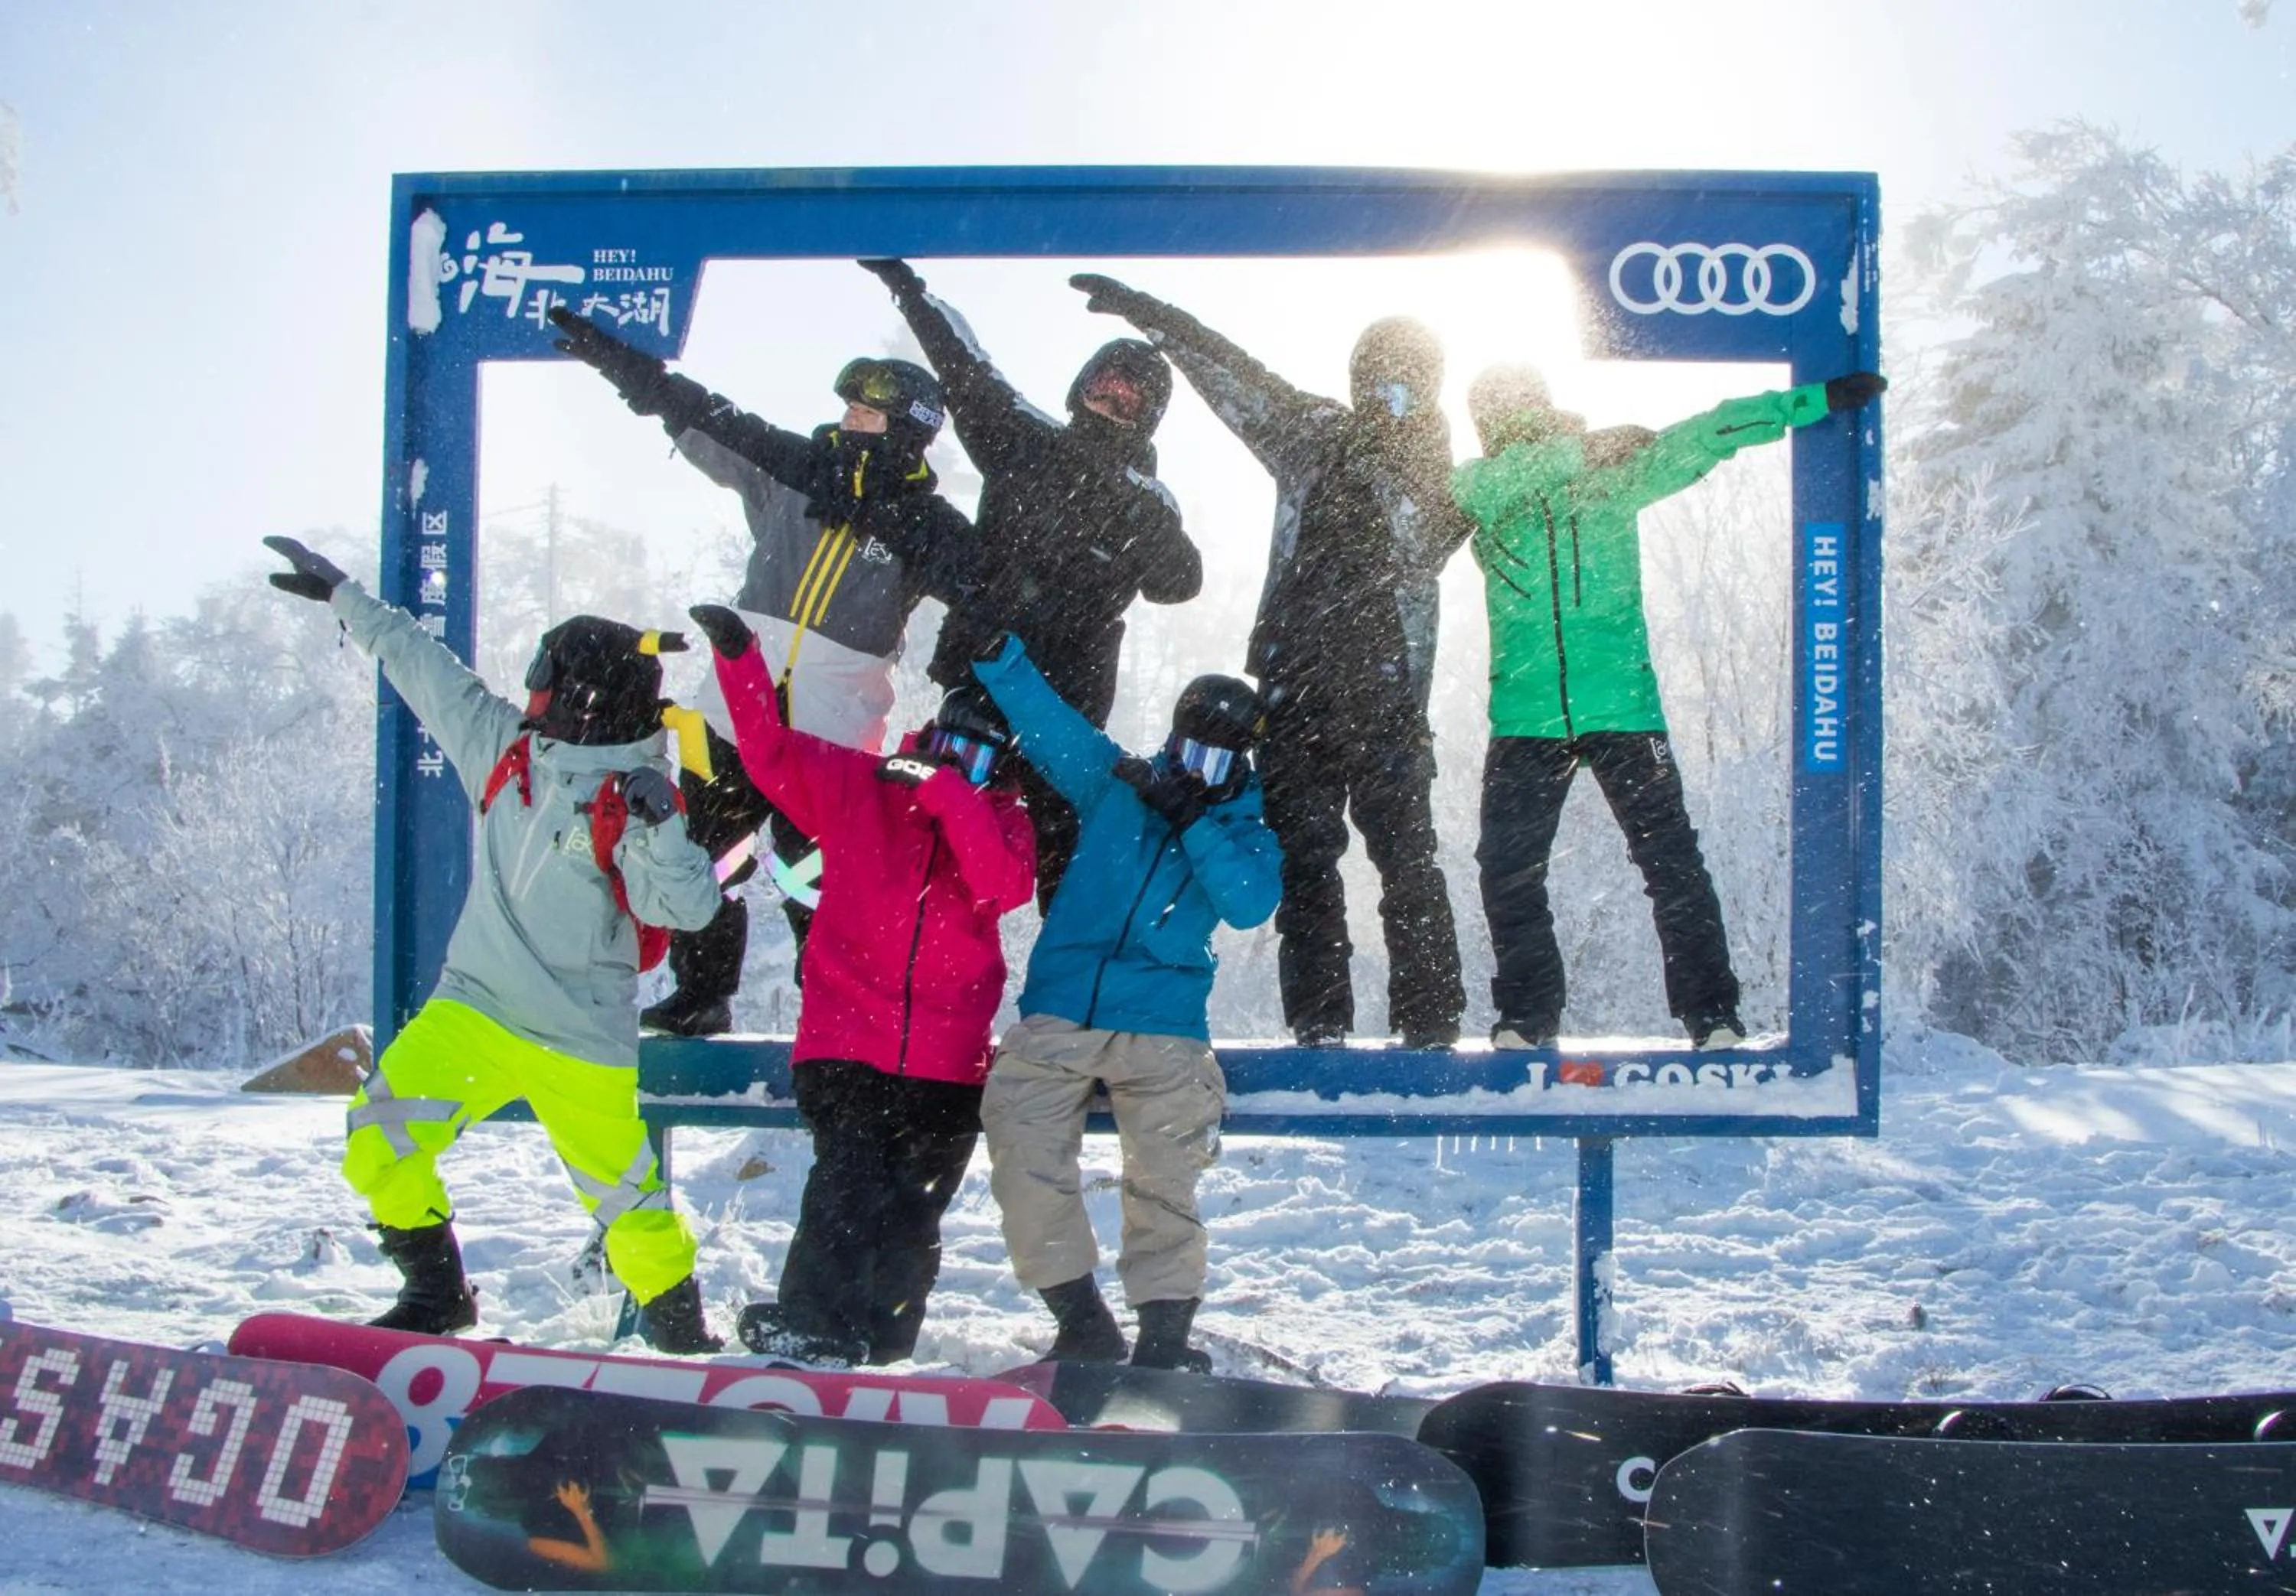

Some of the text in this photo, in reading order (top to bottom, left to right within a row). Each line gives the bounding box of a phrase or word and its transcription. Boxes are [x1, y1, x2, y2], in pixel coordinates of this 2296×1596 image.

[592, 267, 674, 282] BEIDAHU
[593, 249, 637, 263] HEY!
[1813, 536, 1838, 761] HEY! BEIDAHU
[0, 1338, 354, 1528] OGAS
